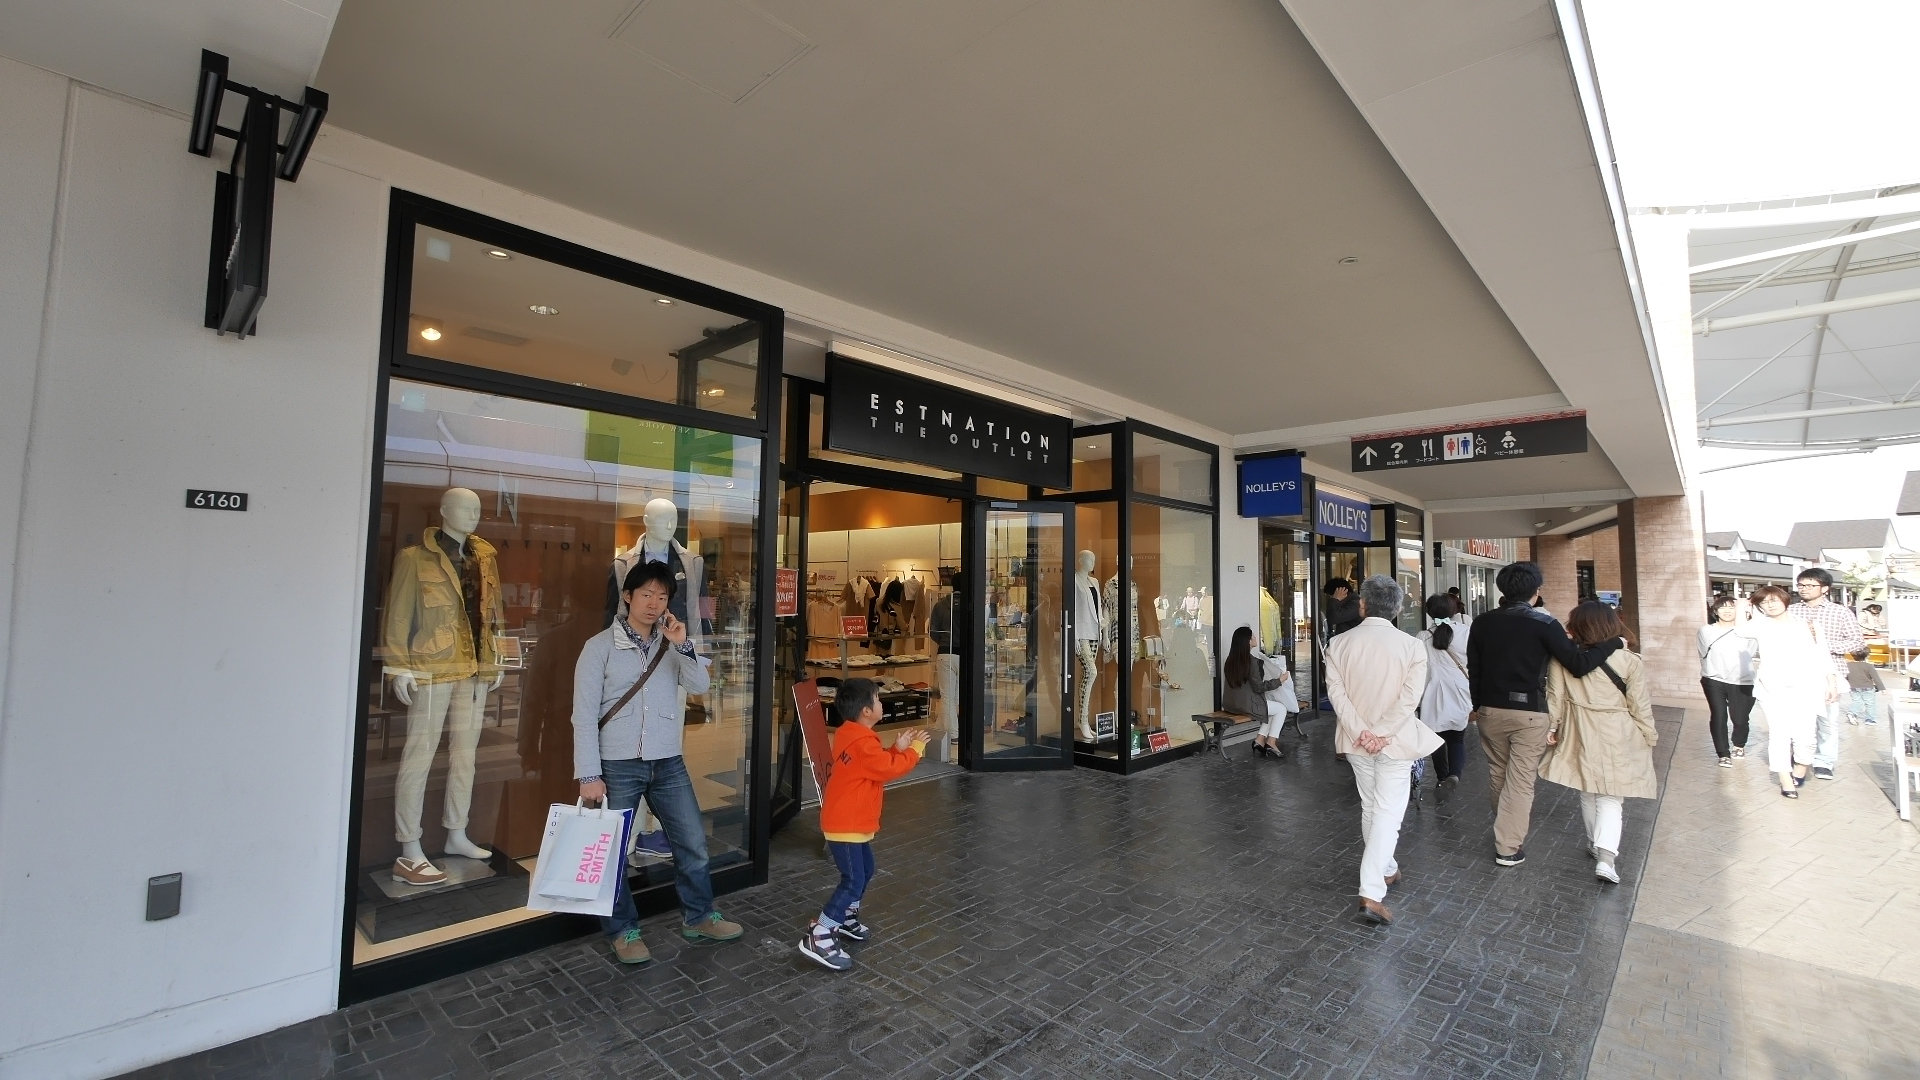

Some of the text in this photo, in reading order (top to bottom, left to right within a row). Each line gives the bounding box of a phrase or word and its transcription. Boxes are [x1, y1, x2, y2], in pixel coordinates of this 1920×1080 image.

[870, 393, 1049, 450] ESTNATION
[870, 416, 1049, 464] THE OUTLET
[194, 492, 241, 508] 6160
[1245, 480, 1296, 494] NOLLEY'S
[1319, 499, 1367, 533] NOLLEY'S
[576, 843, 596, 883] PAUL
[589, 833, 611, 884] SMITH
